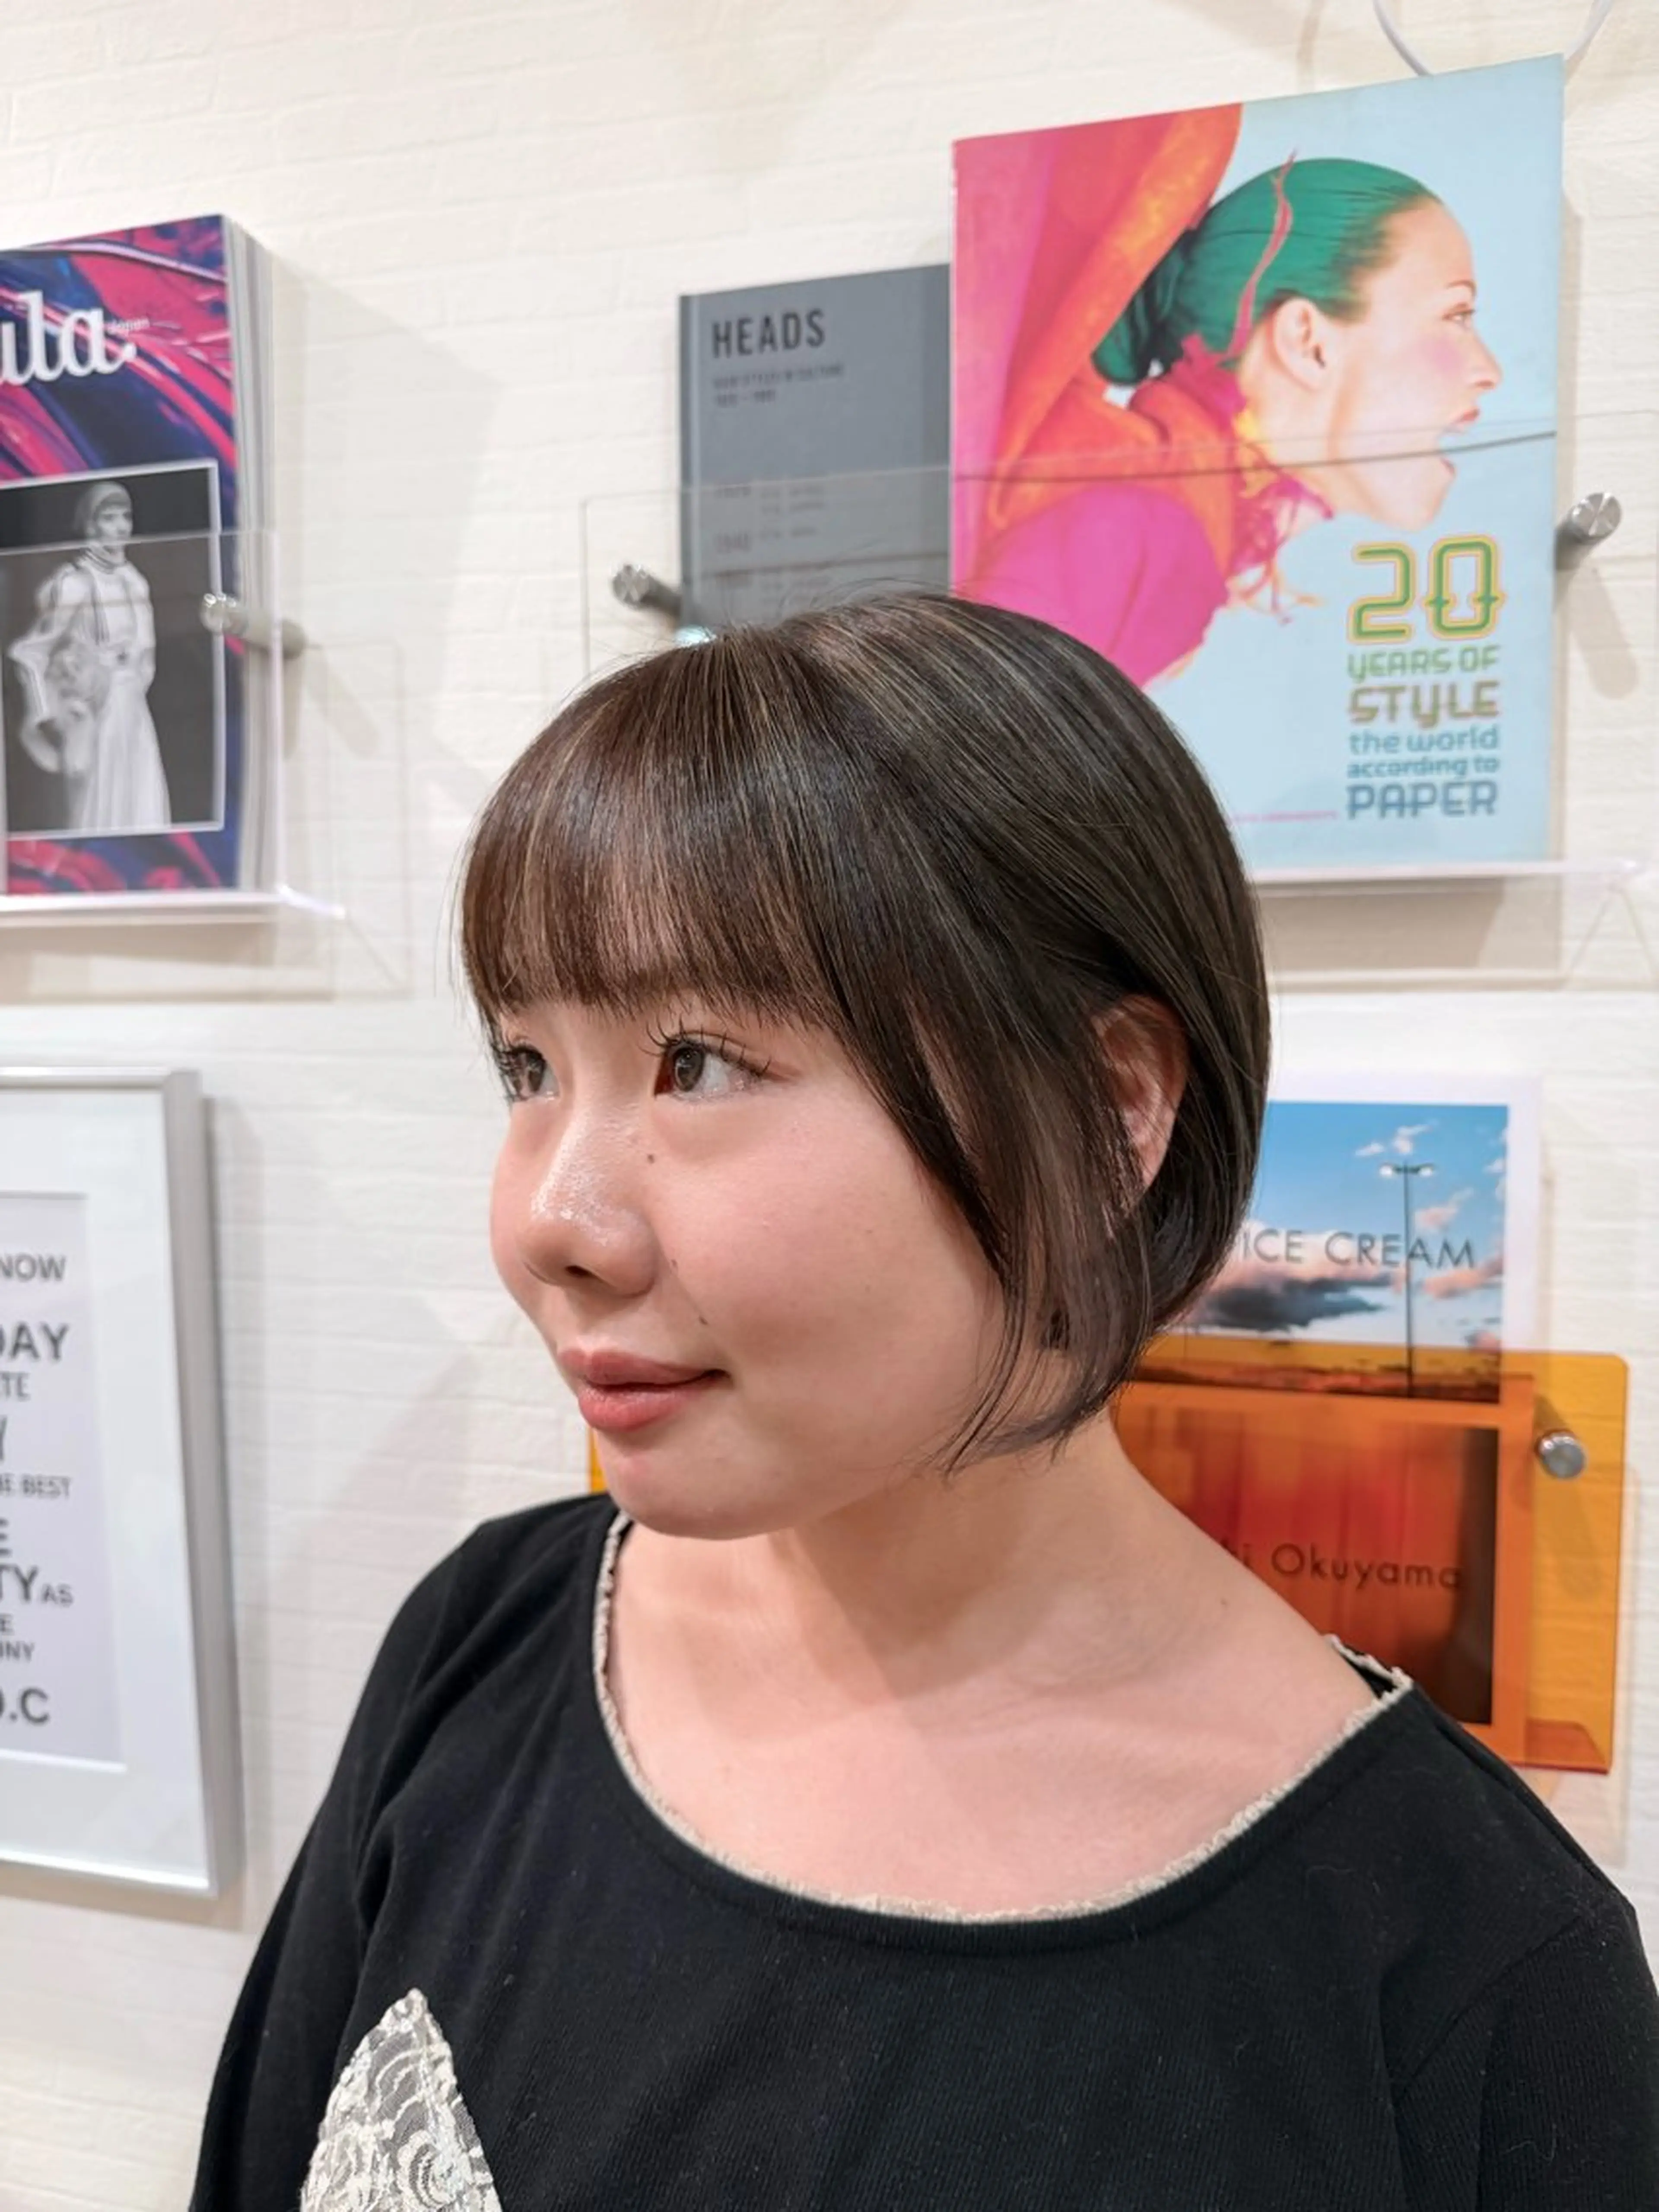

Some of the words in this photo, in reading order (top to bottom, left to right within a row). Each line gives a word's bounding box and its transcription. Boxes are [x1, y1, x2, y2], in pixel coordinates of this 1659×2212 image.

[712, 308, 825, 359] HEADS
[1346, 535, 1506, 644] 20
[1457, 645, 1501, 673] OF
[1347, 680, 1501, 729] STYLE
[1348, 728, 1401, 755] the
[1406, 725, 1501, 752] world
[1347, 756, 1468, 779] according
[1472, 754, 1501, 774] to
[1346, 780, 1498, 820] PAPER
[1242, 1228, 1304, 1264] ICE
[1325, 1232, 1475, 1268] CREAM
[0, 1320, 69, 1361] AY
[1271, 1543, 1464, 1591] Okuyama
